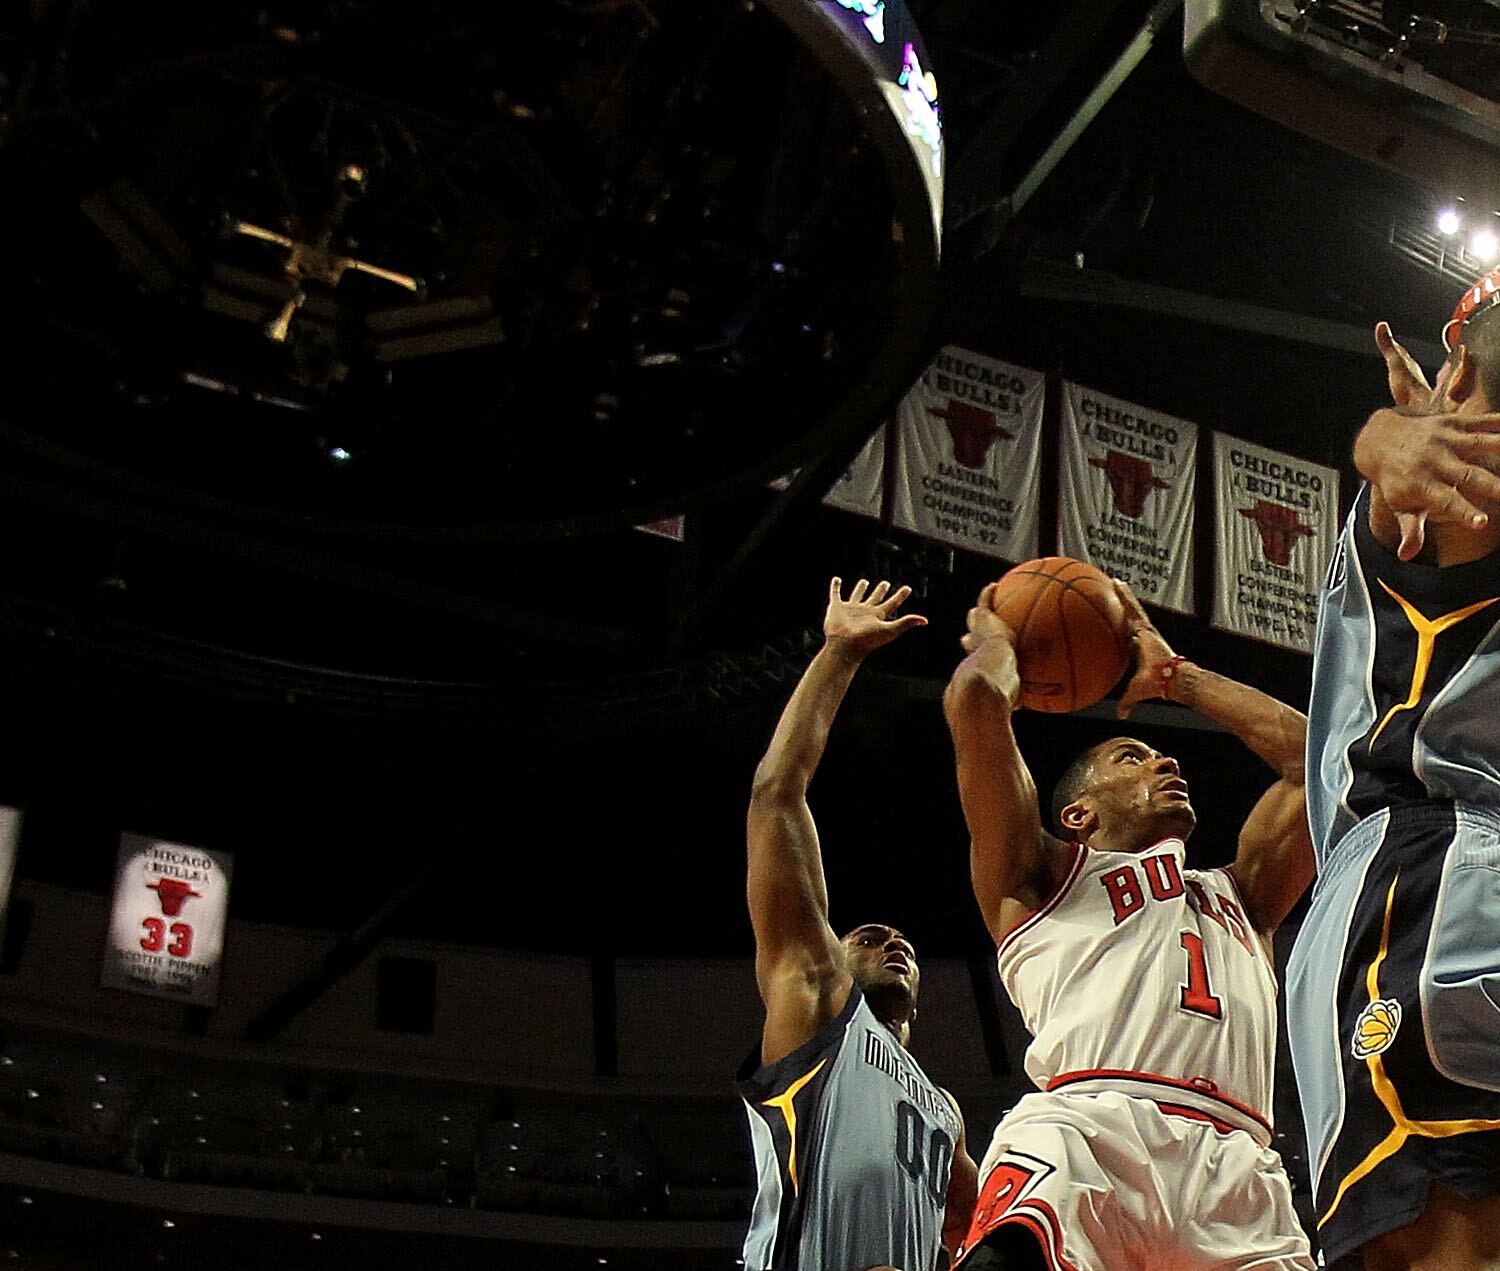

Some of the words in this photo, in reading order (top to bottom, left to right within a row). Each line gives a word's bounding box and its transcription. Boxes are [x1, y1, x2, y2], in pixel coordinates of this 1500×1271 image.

[936, 356, 1025, 394] HICAGO
[1081, 399, 1178, 446] CHICAGO
[1097, 425, 1165, 461] BULLS
[1231, 450, 1322, 493] CHICAGO
[1246, 475, 1310, 508] BULLS
[147, 848, 213, 871] CHICAGO
[140, 918, 192, 958] 33
[1180, 931, 1223, 1020] 1
[896, 1100, 953, 1213] 00
